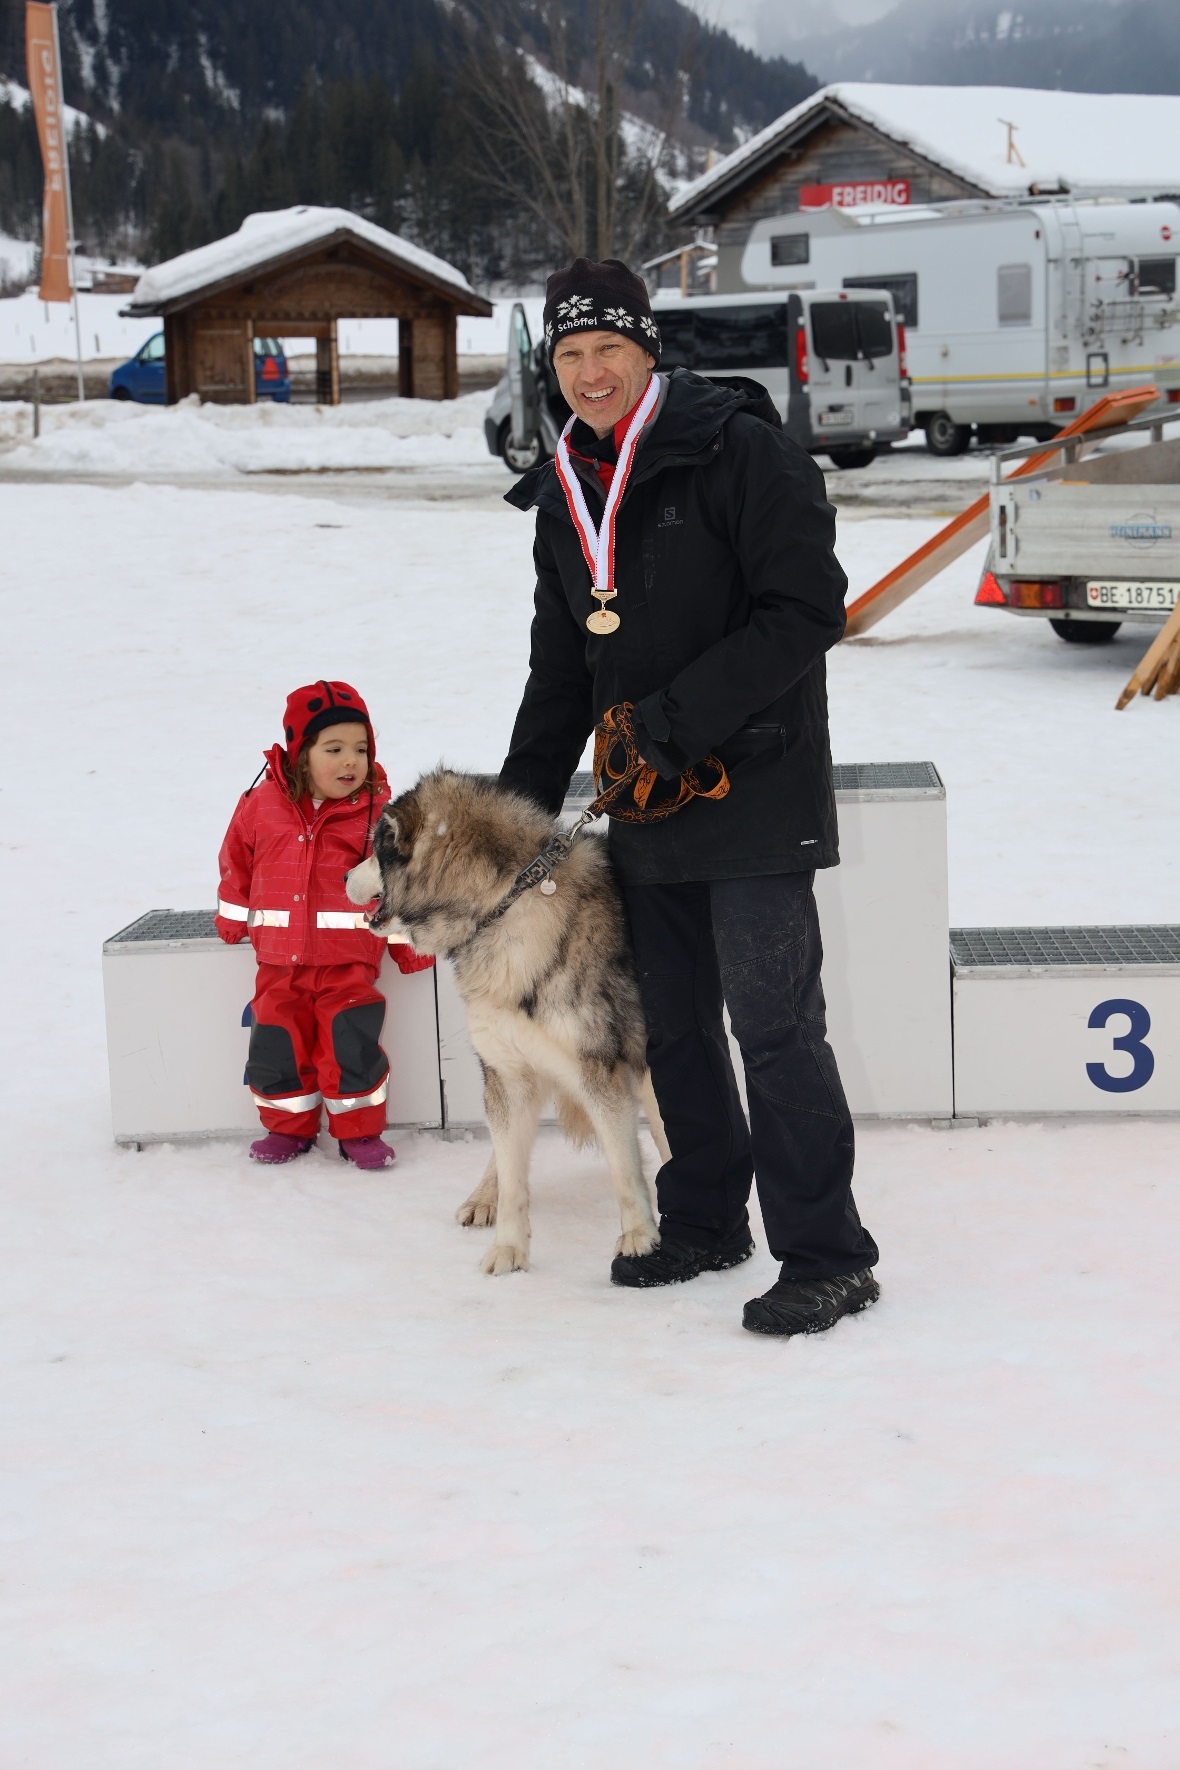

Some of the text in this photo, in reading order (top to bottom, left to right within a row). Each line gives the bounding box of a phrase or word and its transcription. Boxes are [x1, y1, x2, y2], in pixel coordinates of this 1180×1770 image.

[832, 183, 907, 207] FREIDIG
[557, 317, 598, 332] Schöffel
[1126, 587, 1180, 605] 18751
[1085, 998, 1155, 1093] 3
